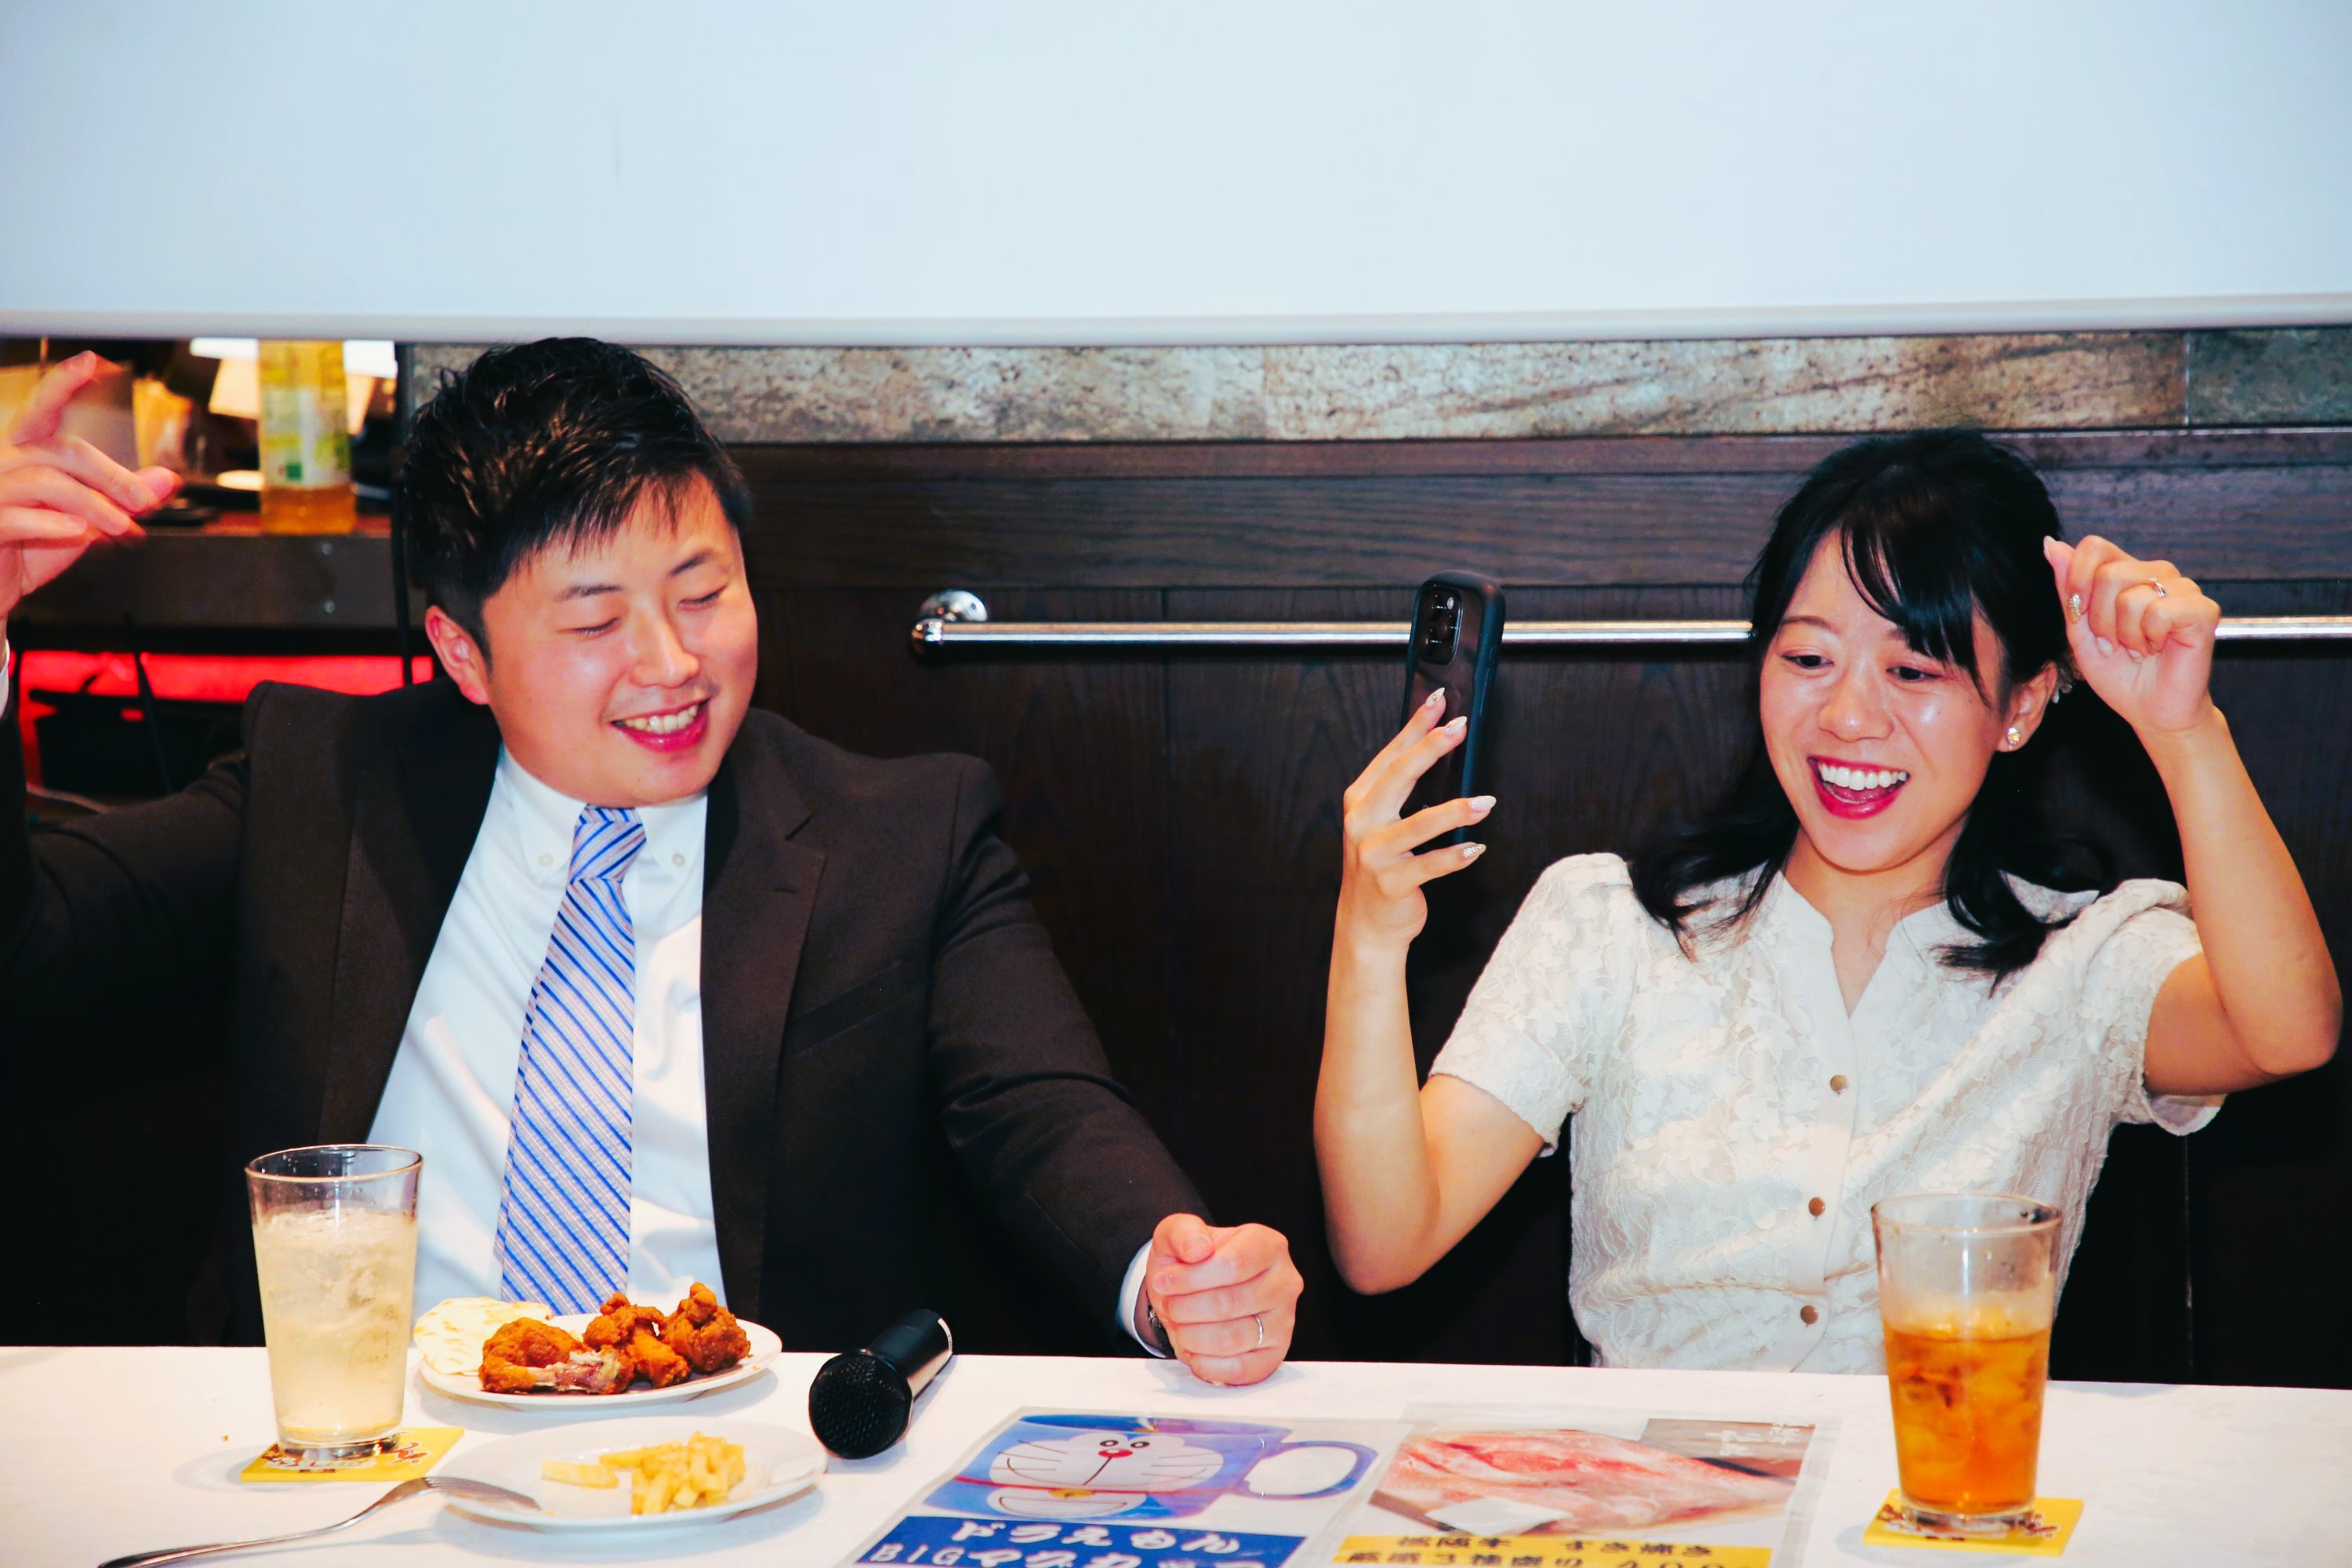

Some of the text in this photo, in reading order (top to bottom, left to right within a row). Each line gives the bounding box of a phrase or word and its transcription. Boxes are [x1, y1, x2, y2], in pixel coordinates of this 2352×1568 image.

[950, 1521, 1240, 1554] ドラえもん
